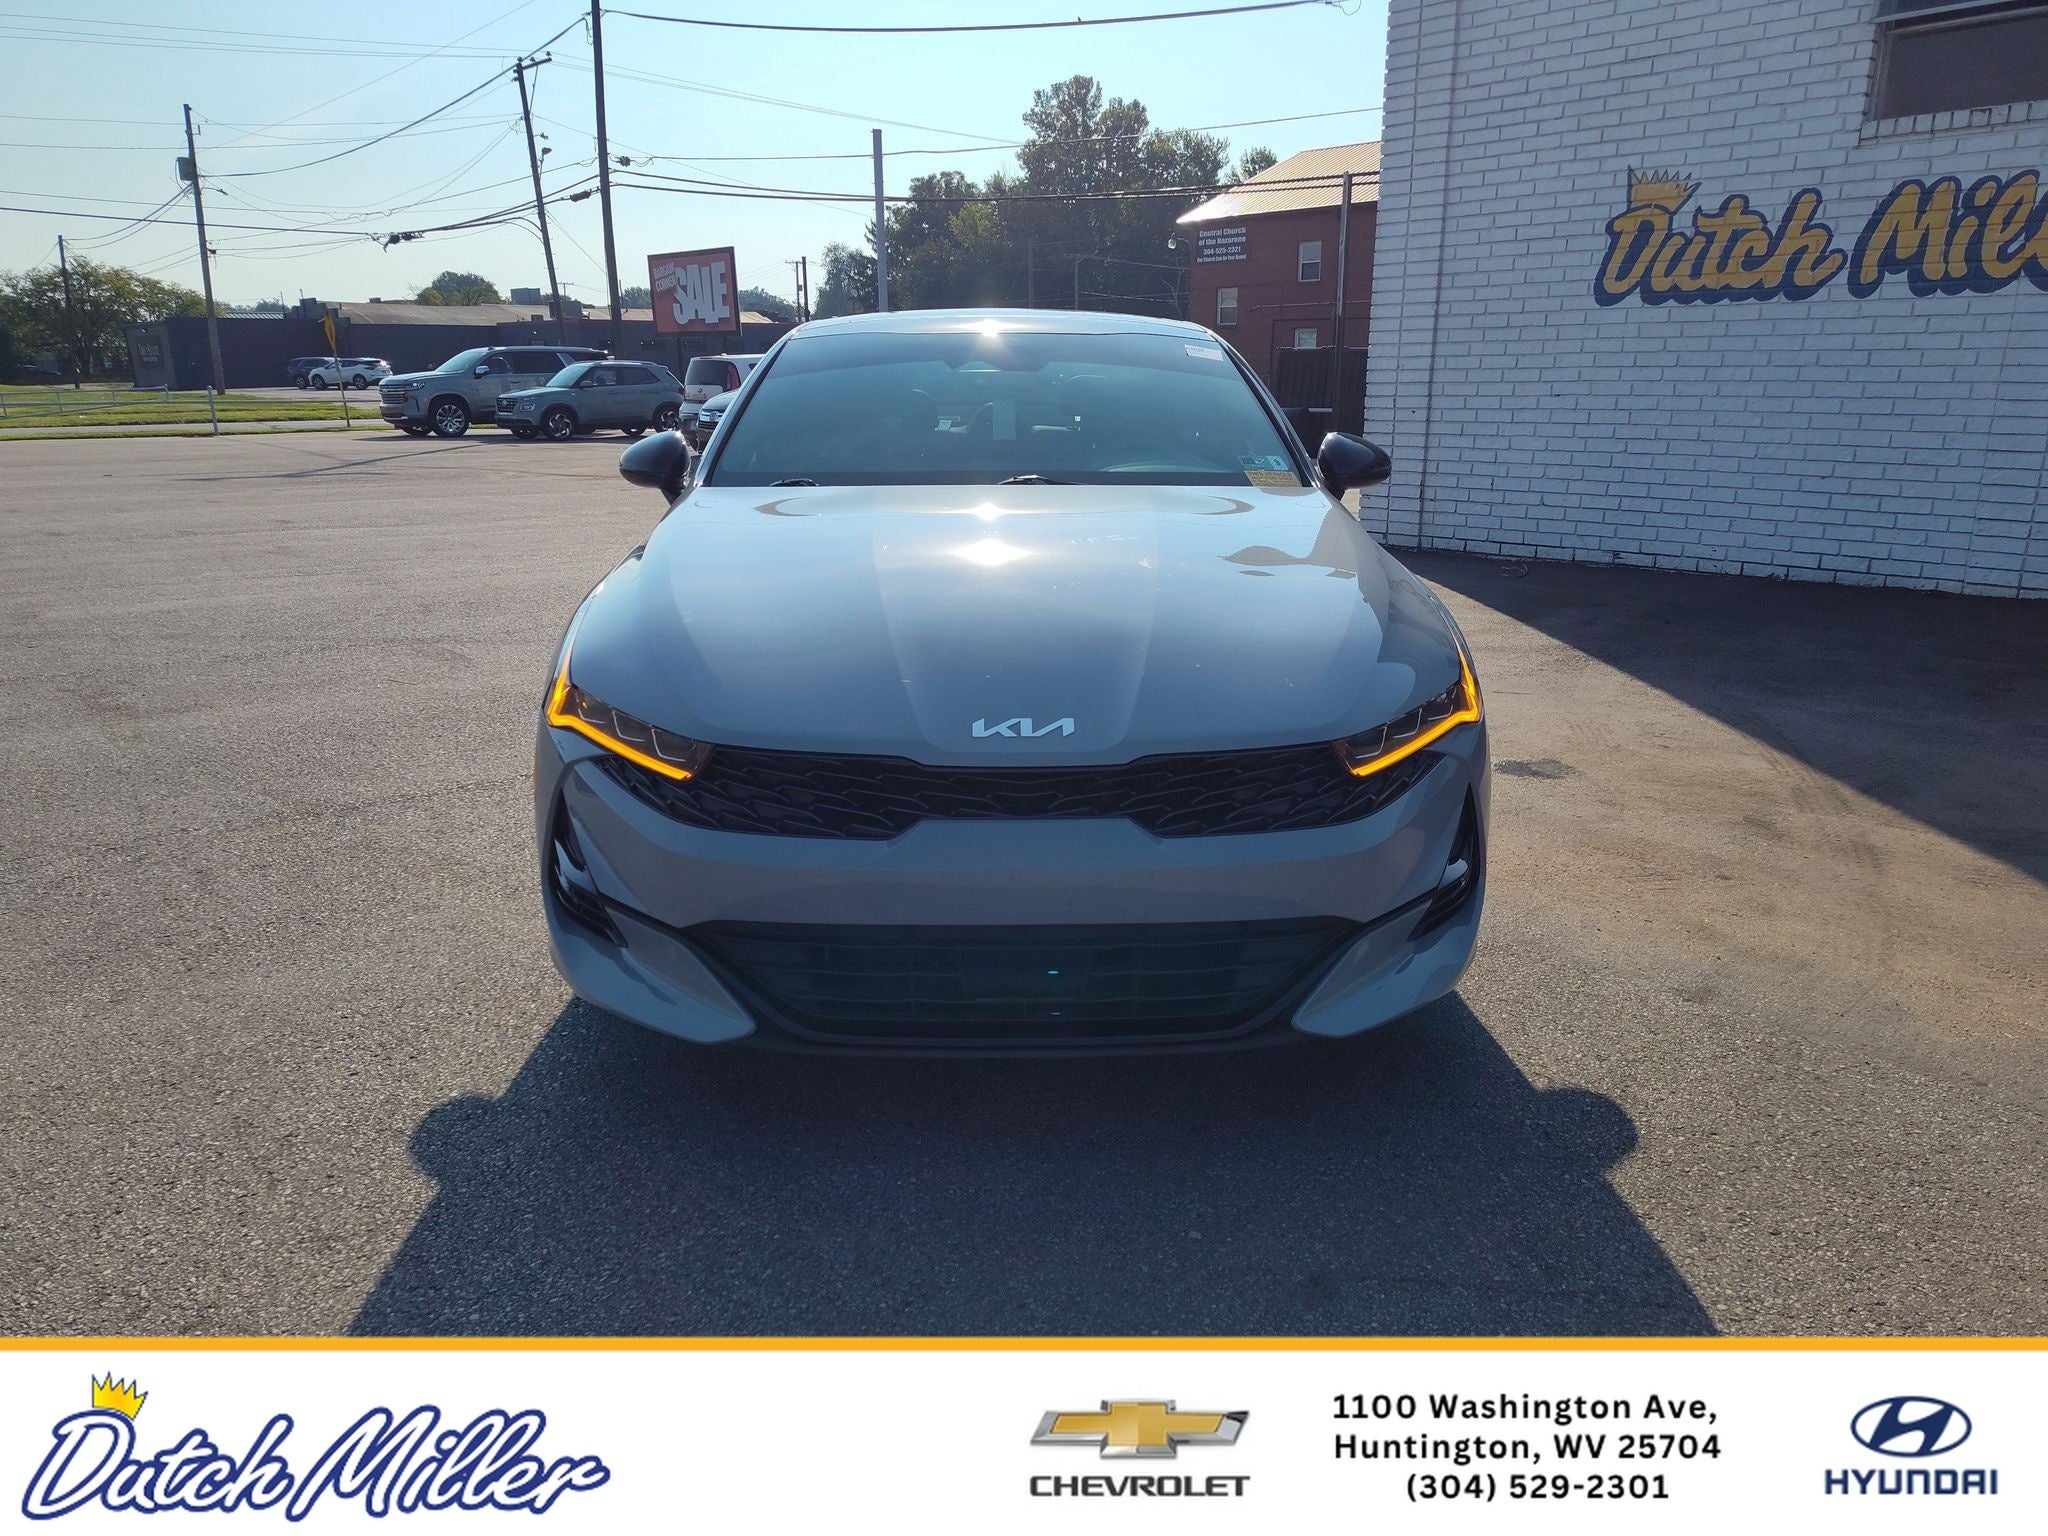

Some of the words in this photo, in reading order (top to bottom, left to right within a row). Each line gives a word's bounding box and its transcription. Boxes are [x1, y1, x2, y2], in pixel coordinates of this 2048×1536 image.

[1199, 229, 1222, 238] Central
[1223, 226, 1246, 235] Church
[1217, 236, 1247, 244] Nazarene
[1594, 186, 1847, 307] Dutch
[1846, 169, 2048, 299] Mil
[653, 262, 675, 280] BARGAIN
[655, 273, 677, 292] CORNER
[673, 261, 730, 325] SALE
